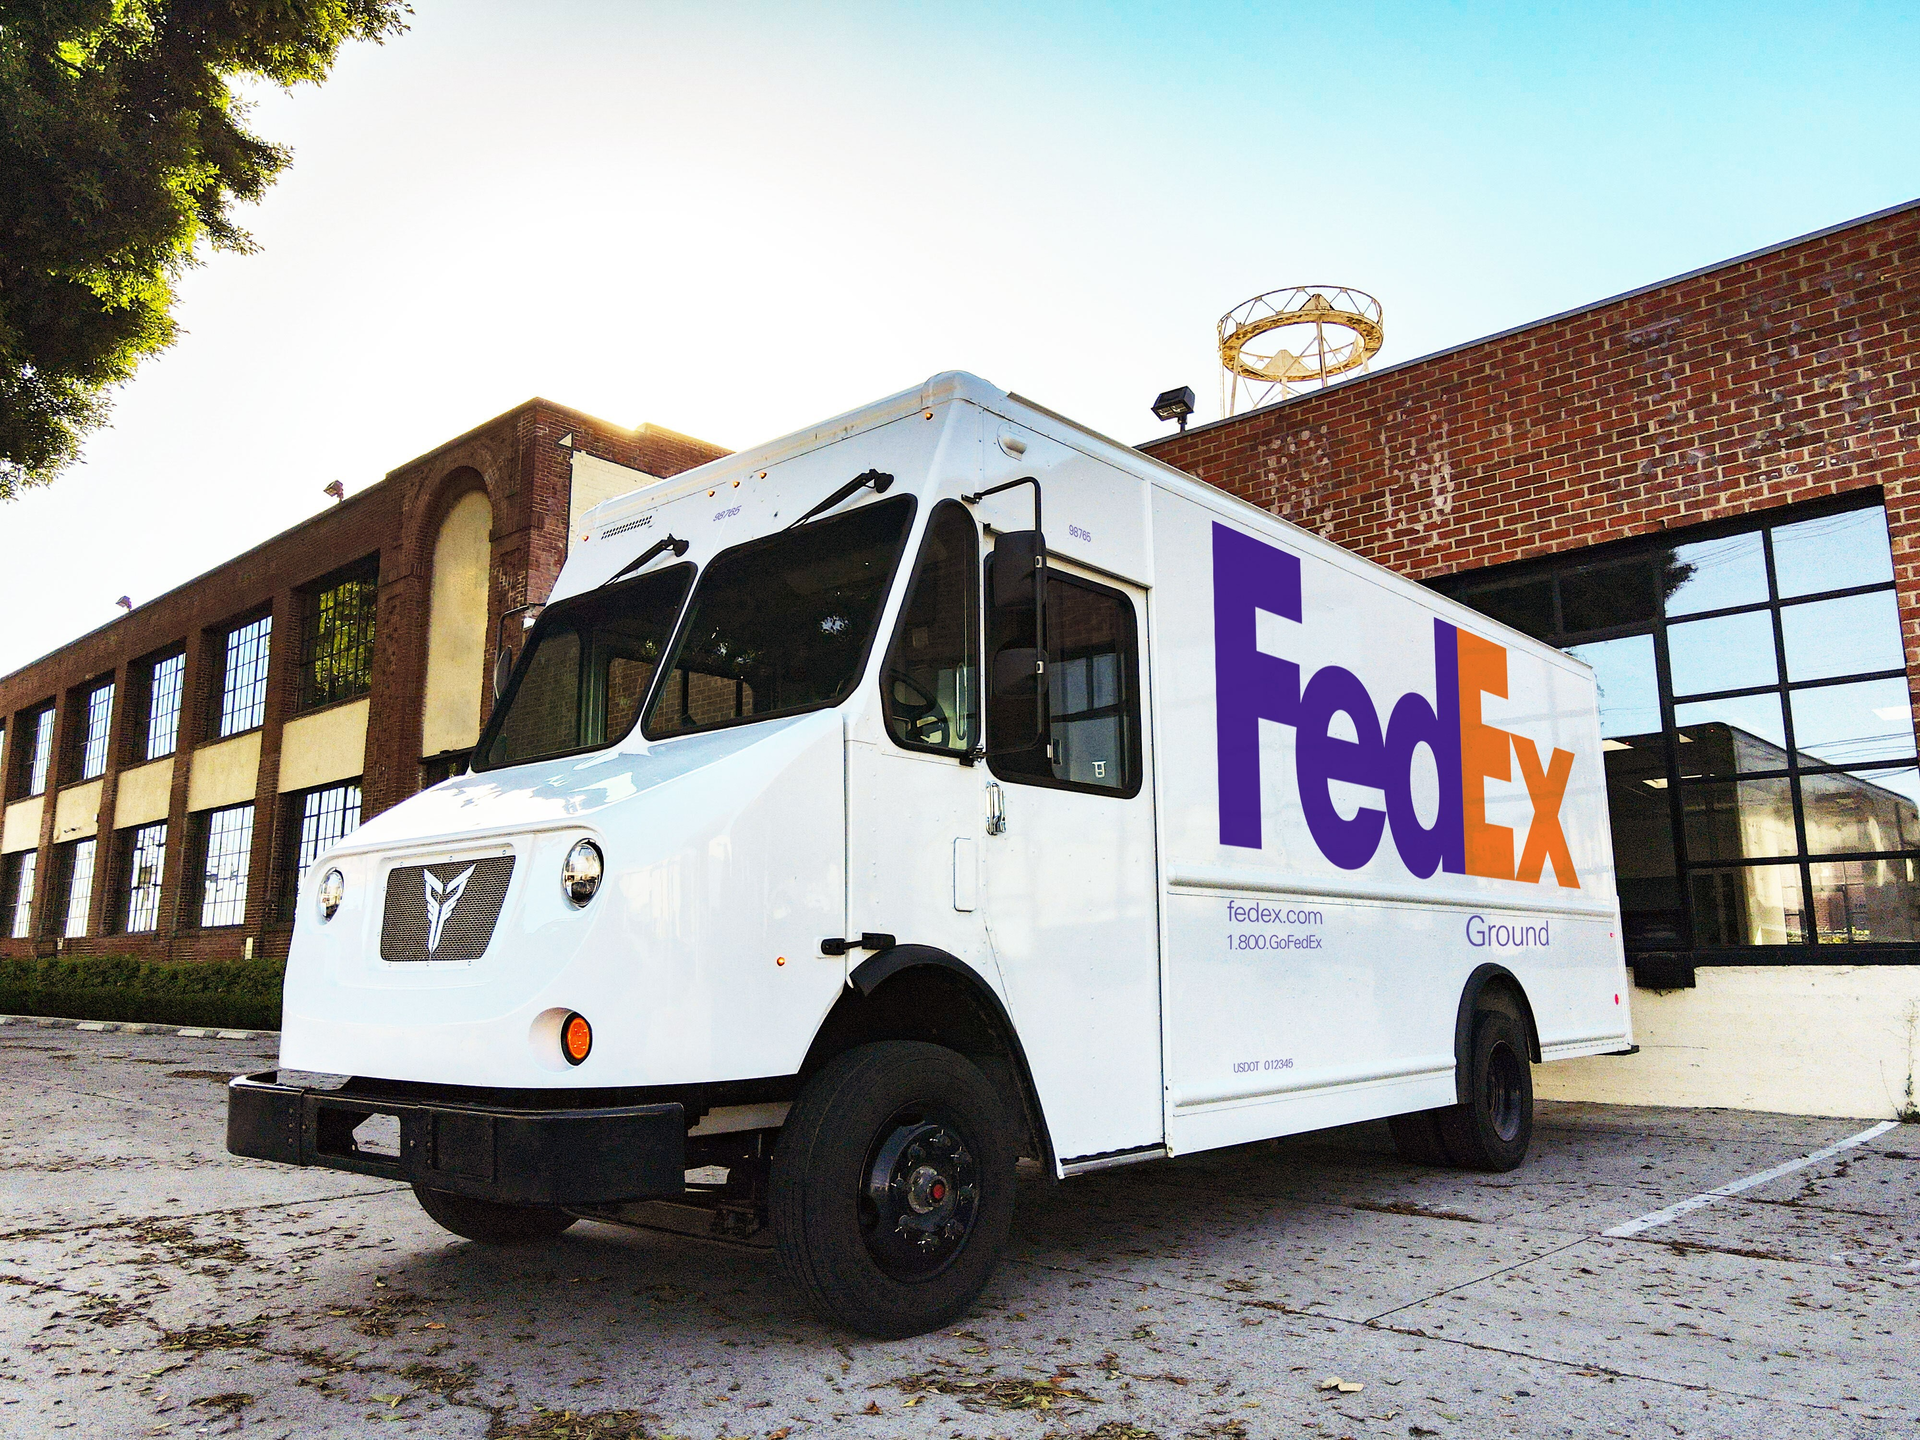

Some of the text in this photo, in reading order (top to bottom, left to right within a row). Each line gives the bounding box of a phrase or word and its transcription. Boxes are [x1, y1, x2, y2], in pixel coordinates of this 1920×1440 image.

[713, 505, 742, 521] 98765
[1068, 524, 1092, 542] 98765
[1212, 520, 1581, 889] FedEx
[1227, 900, 1323, 925] fedex.com
[1466, 915, 1549, 947] Ground
[1227, 934, 1322, 950] 1.800.GoFedEx
[1233, 1058, 1294, 1073] USDOT 012345
